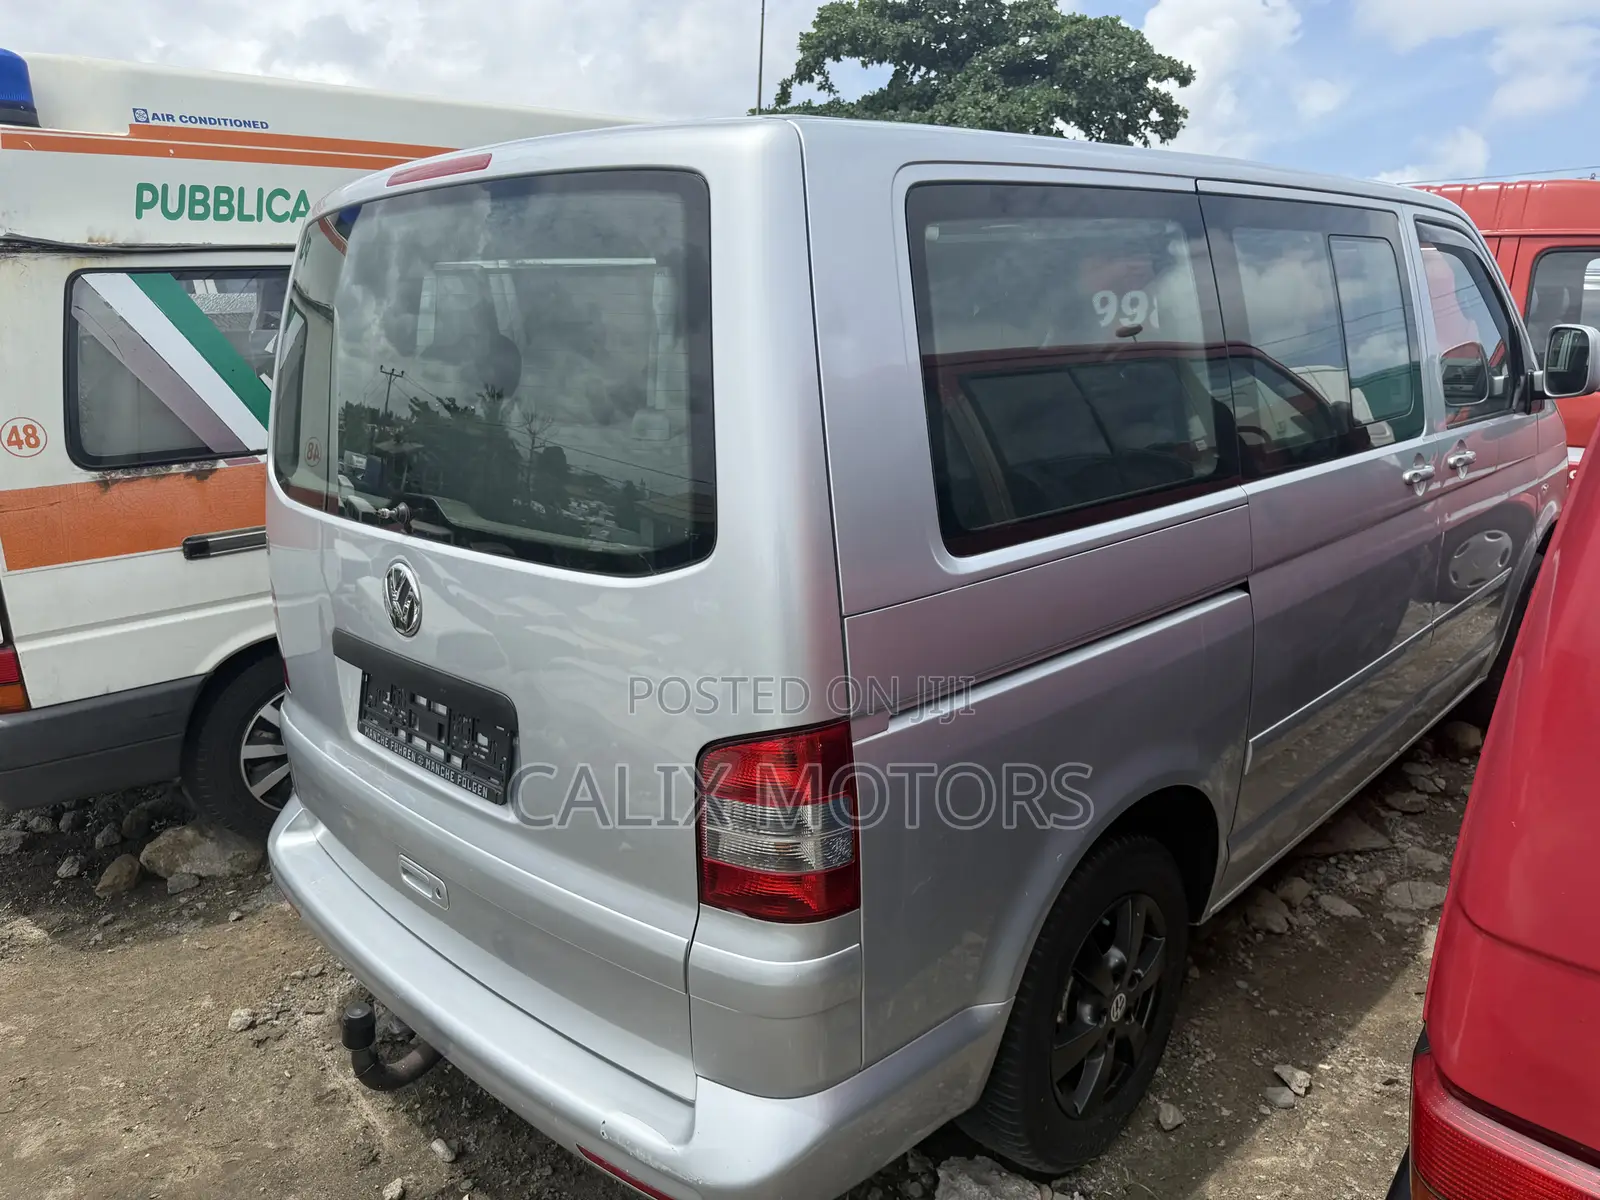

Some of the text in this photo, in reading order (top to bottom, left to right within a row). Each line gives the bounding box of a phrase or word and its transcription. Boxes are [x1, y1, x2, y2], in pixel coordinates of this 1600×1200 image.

[151, 112, 269, 130] AIR CONDITIONED
[135, 182, 311, 224] PUBBLICA
[7, 424, 40, 450] 48
[364, 725, 389, 748] MANCHE
[425, 758, 455, 782] MANCHE
[457, 774, 489, 799] FOLGEN
